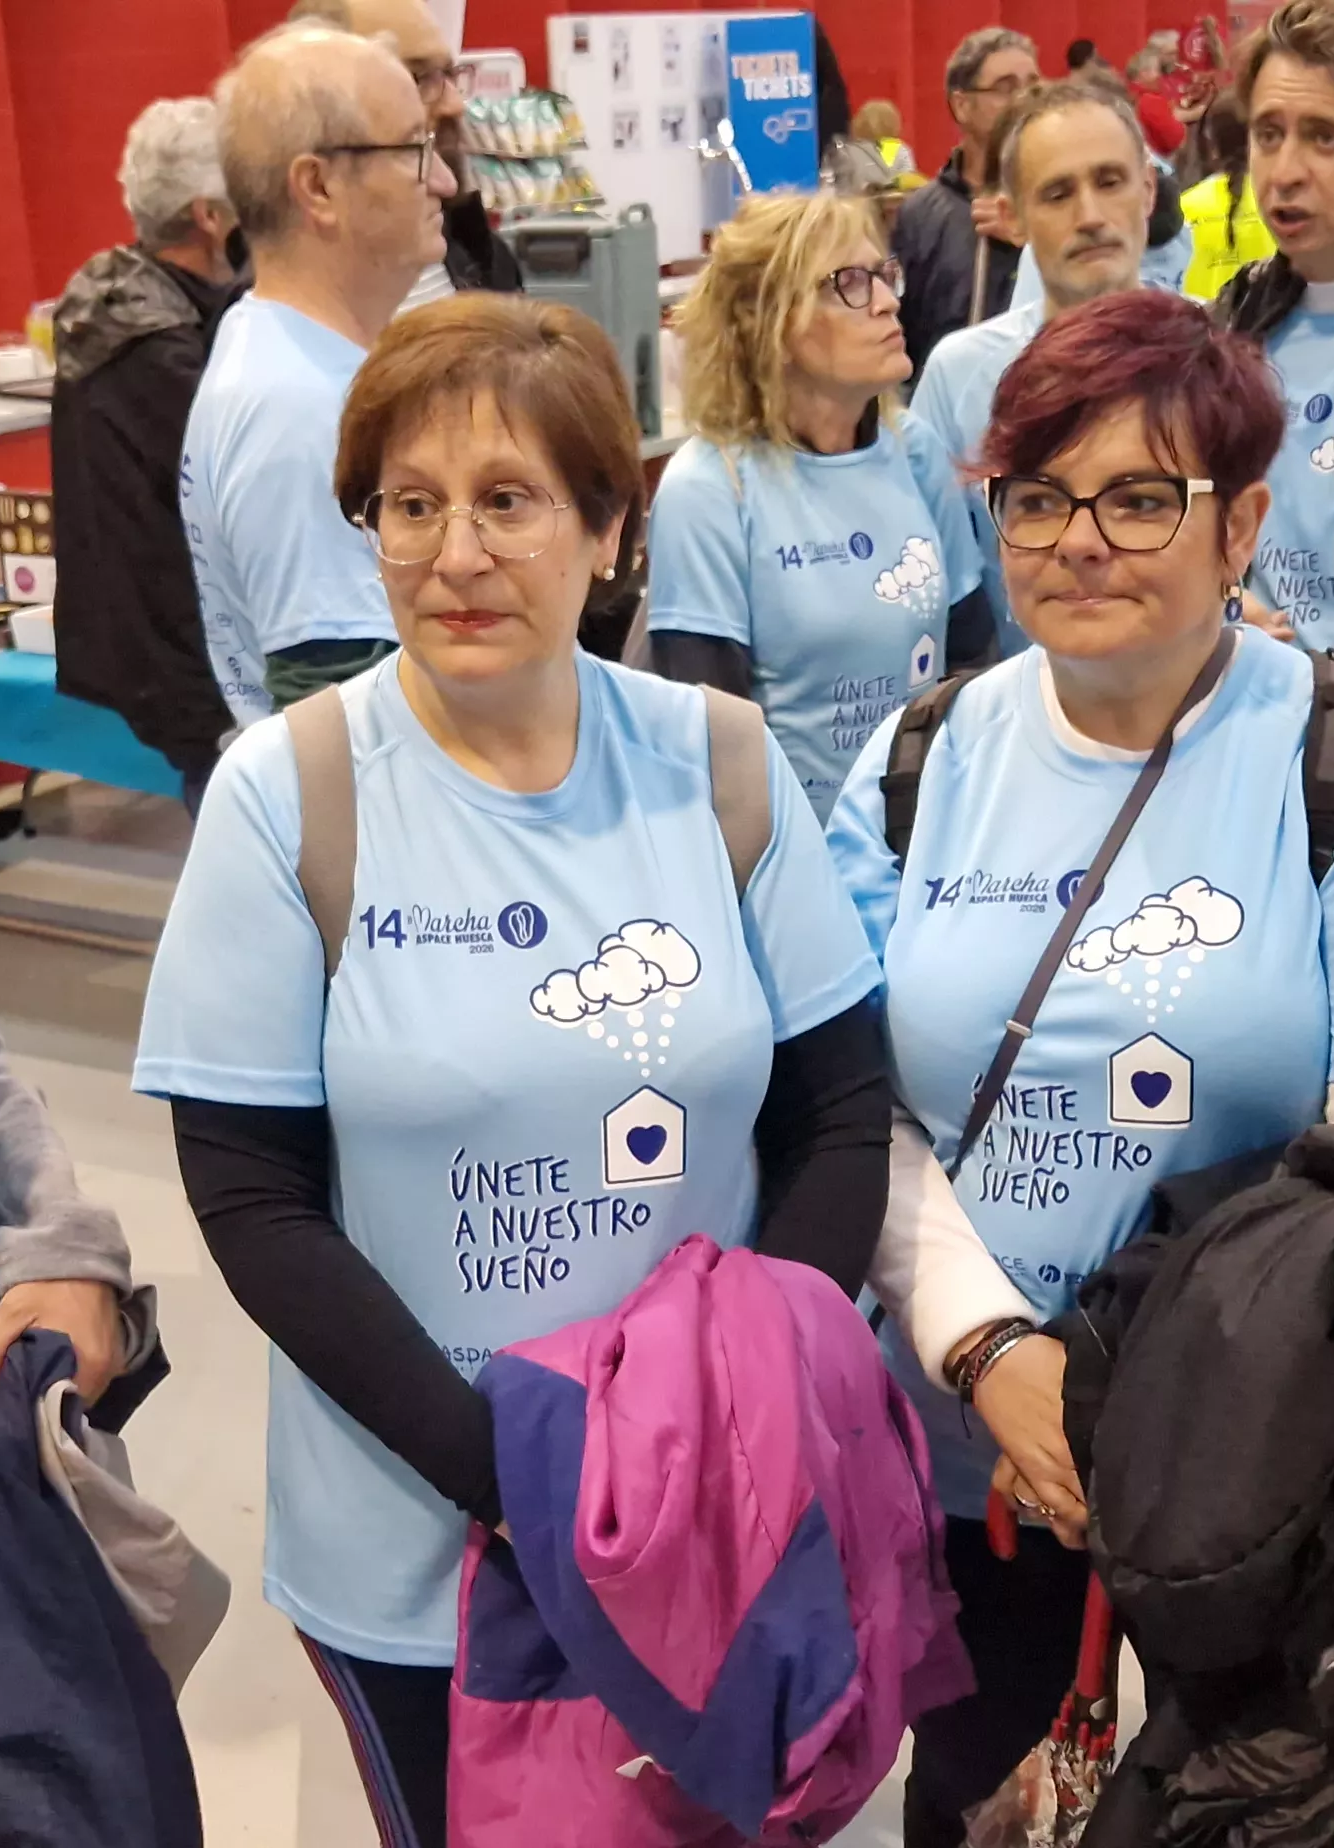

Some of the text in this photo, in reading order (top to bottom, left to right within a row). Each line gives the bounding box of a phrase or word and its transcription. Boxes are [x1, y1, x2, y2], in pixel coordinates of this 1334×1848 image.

[743, 73, 812, 101] TICKETS
[1259, 537, 1321, 573] ÚNETE
[832, 674, 896, 702] ÚNETE
[831, 705, 845, 726] A
[831, 725, 878, 752] SUE
[972, 869, 1049, 895] Marcha
[968, 893, 1048, 904] ASPACE HUESCA
[412, 903, 492, 934] Marcha
[415, 932, 494, 945] ASPACE HUESCA
[972, 1073, 1078, 1123] NETE
[984, 1126, 1152, 1171] A NUESTRO
[450, 1148, 570, 1202] ÚNETE
[978, 1166, 1070, 1211] SUEÑO
[454, 1197, 651, 1248] A NUESTRO
[457, 1243, 570, 1294] SUEÑO
